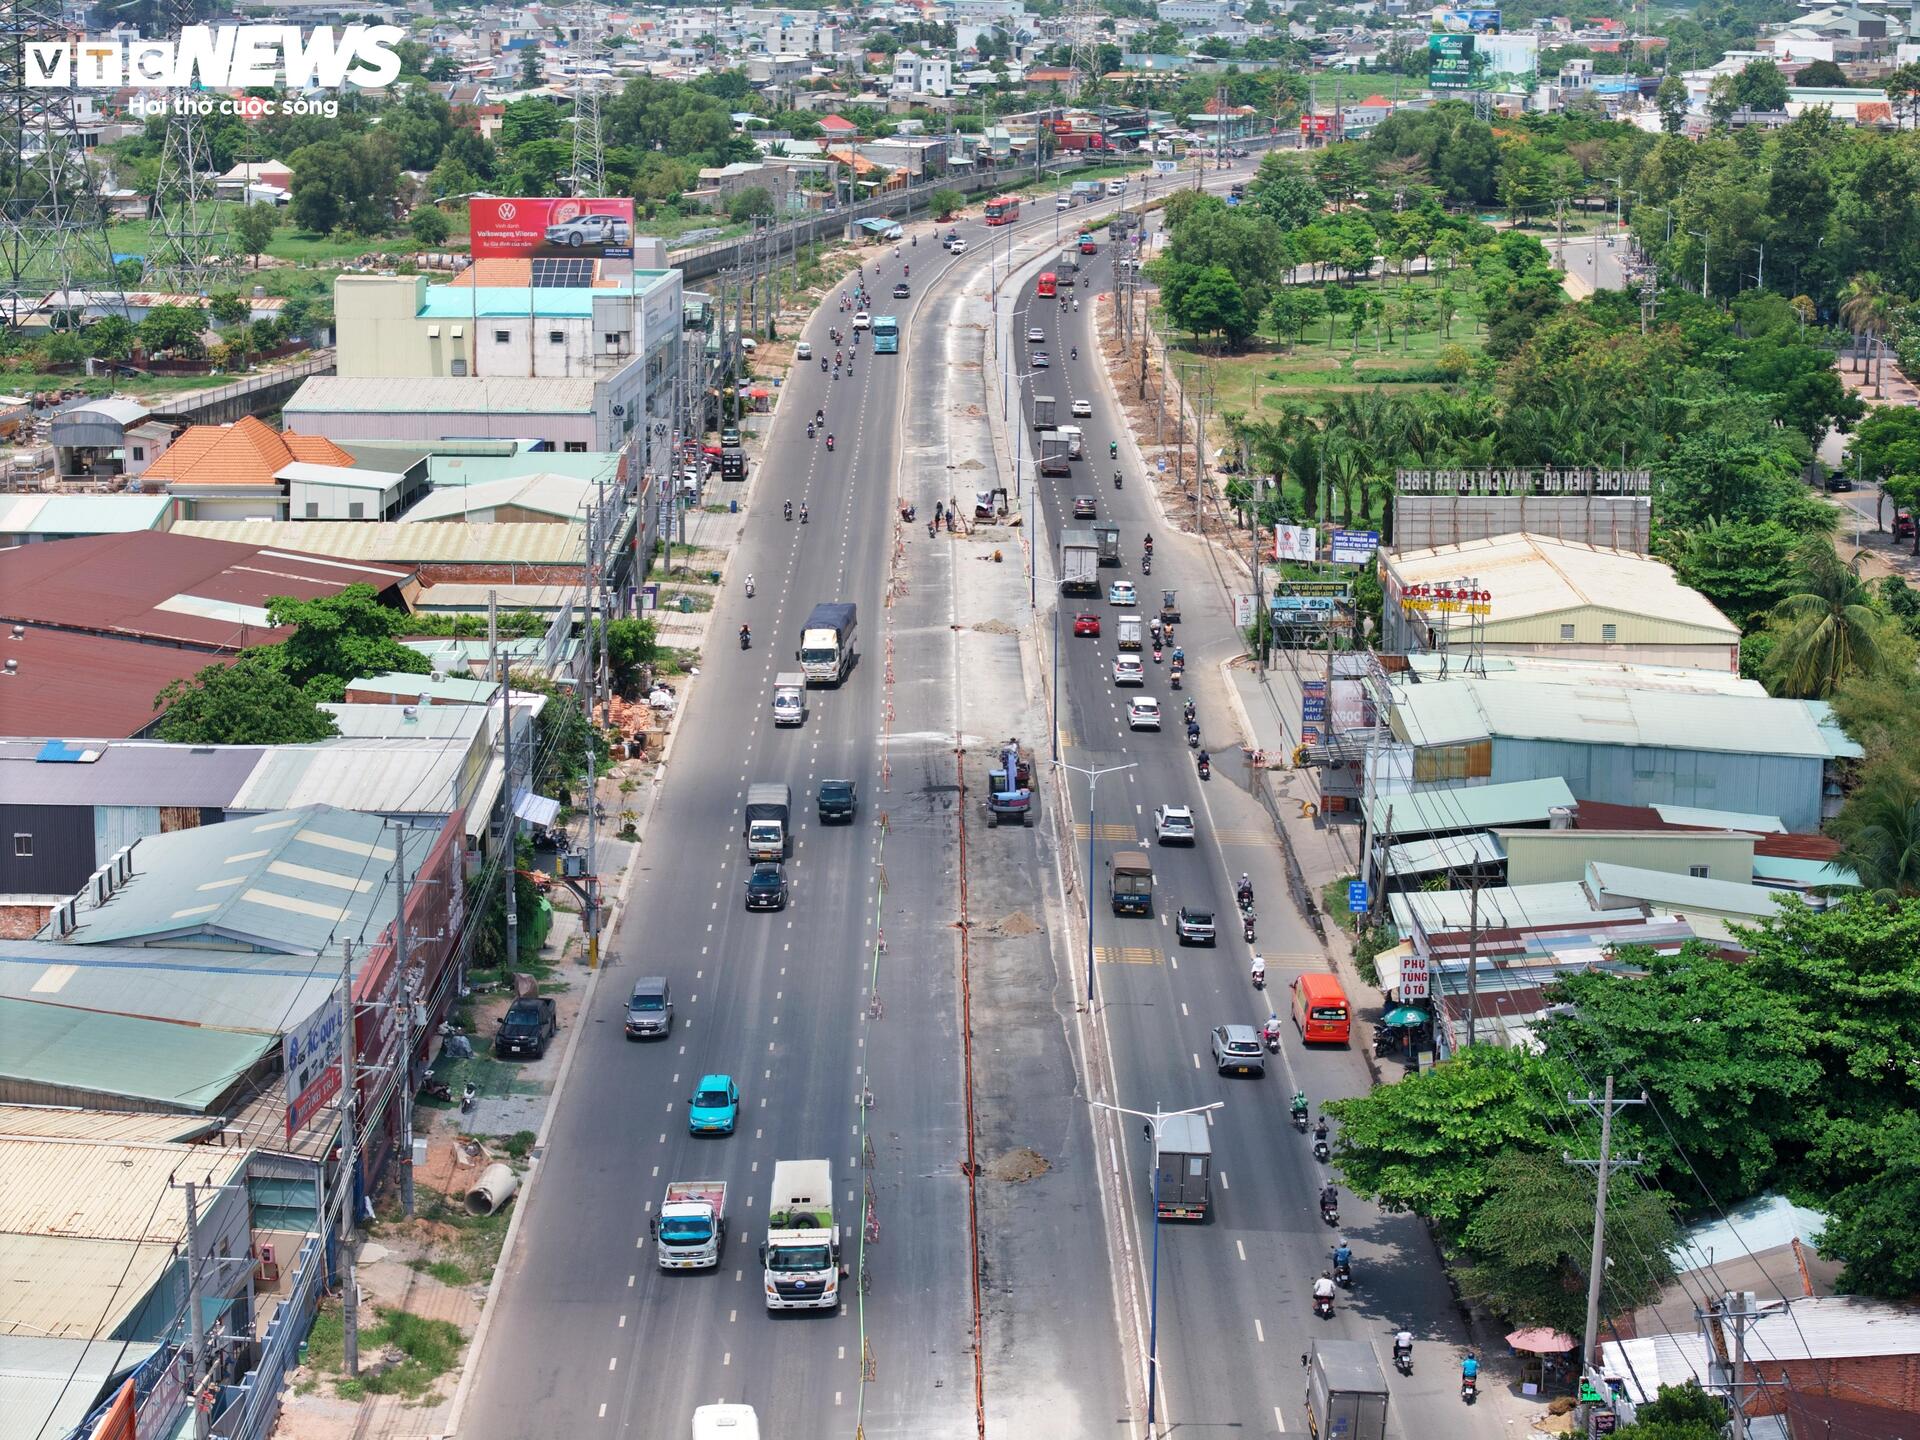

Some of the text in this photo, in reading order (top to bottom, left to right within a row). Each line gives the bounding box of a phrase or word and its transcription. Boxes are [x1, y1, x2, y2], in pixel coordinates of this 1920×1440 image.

[1436, 59, 1457, 69] 750
[477, 230, 513, 240] Volkswagen
[1402, 584, 1491, 601] LỐP XE Ô TÔ
[1403, 959, 1425, 970] PHỤ
[1401, 970, 1428, 982] TÙNG
[1404, 984, 1425, 995] Ô TÔ
